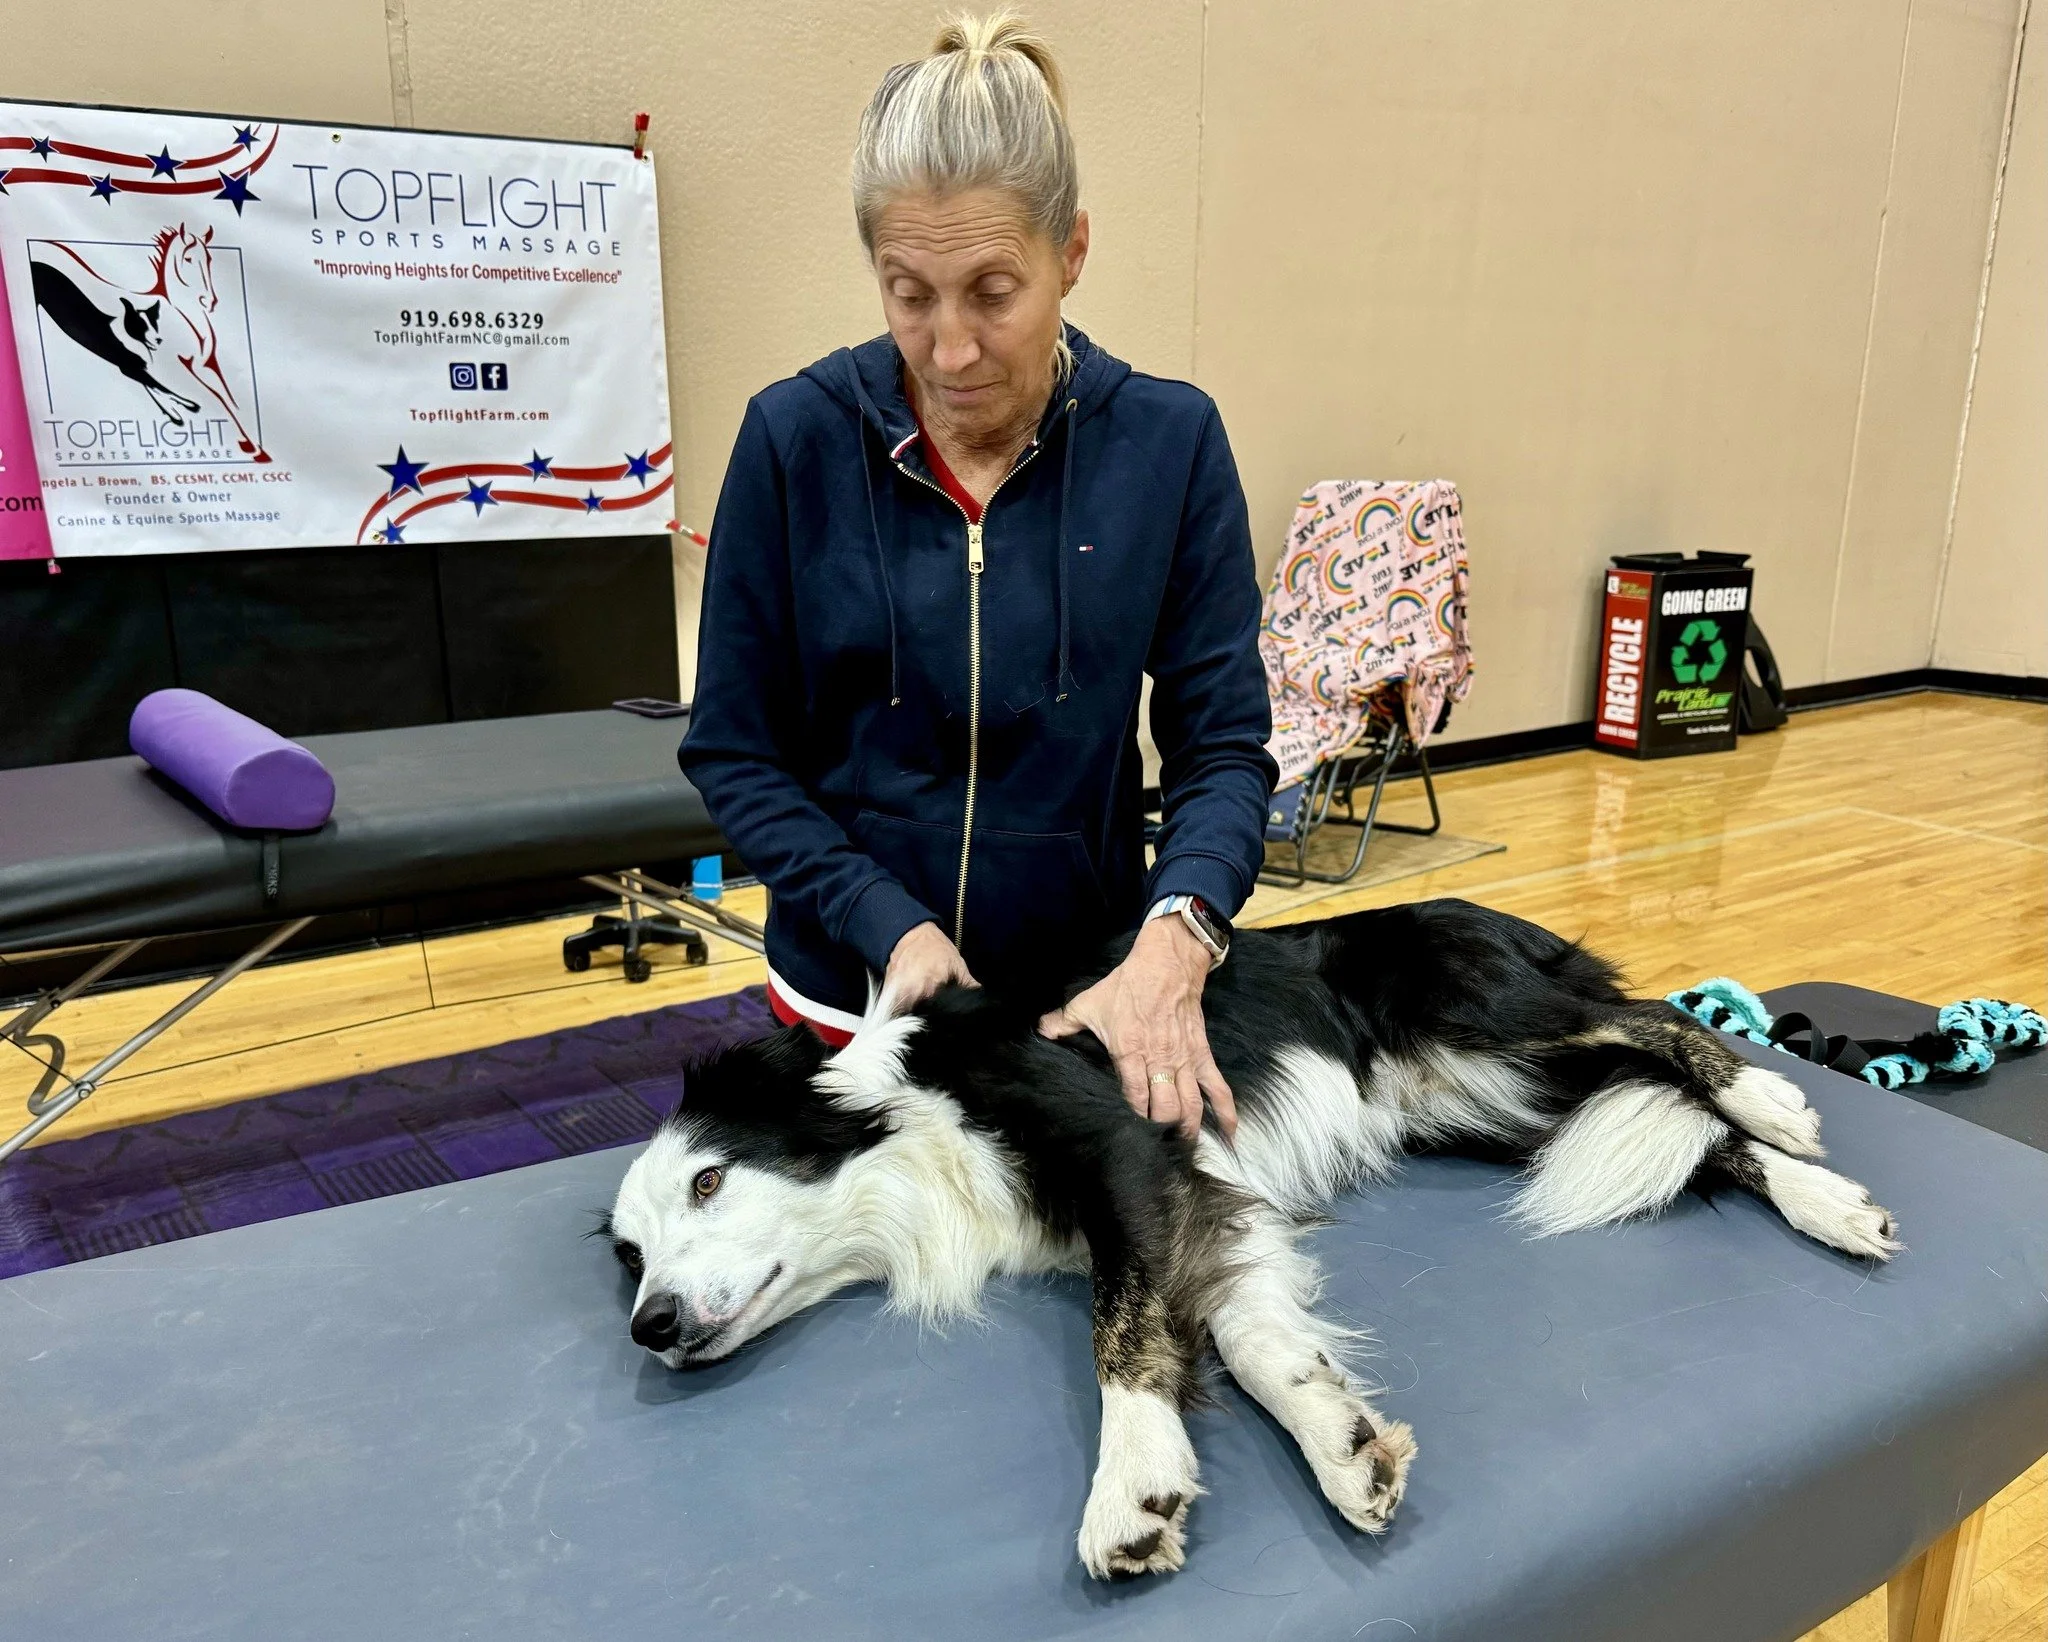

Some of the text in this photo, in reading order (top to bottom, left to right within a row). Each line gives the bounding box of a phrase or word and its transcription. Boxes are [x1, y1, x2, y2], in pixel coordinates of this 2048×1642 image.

[293, 164, 616, 232] TOPFLIGHT
[311, 228, 621, 256] SPORTS MASSAGE
[314, 259, 622, 284] "Improving Heights for Competitive Excellence"
[400, 309, 545, 330] 919.698.6329
[374, 330, 570, 348] TopflightFarmNC@gmail.com
[410, 409, 550, 424] TopflightFarm.com
[43, 419, 229, 448] TOPFLIGHT
[55, 449, 233, 462] SPORTS MASSAGE
[42, 477, 77, 489] ngela
[83, 477, 93, 487] L.
[174, 474, 218, 485] CESMT,
[222, 473, 258, 484] CCMT,
[262, 472, 293, 482] CSCC
[105, 491, 232, 505] Founder & Owner
[57, 511, 281, 527] Canine & Equine Sports Massage
[1662, 589, 1704, 616] GOING
[1704, 586, 1747, 613] GREEN
[1604, 617, 1643, 724] RECYCLE
